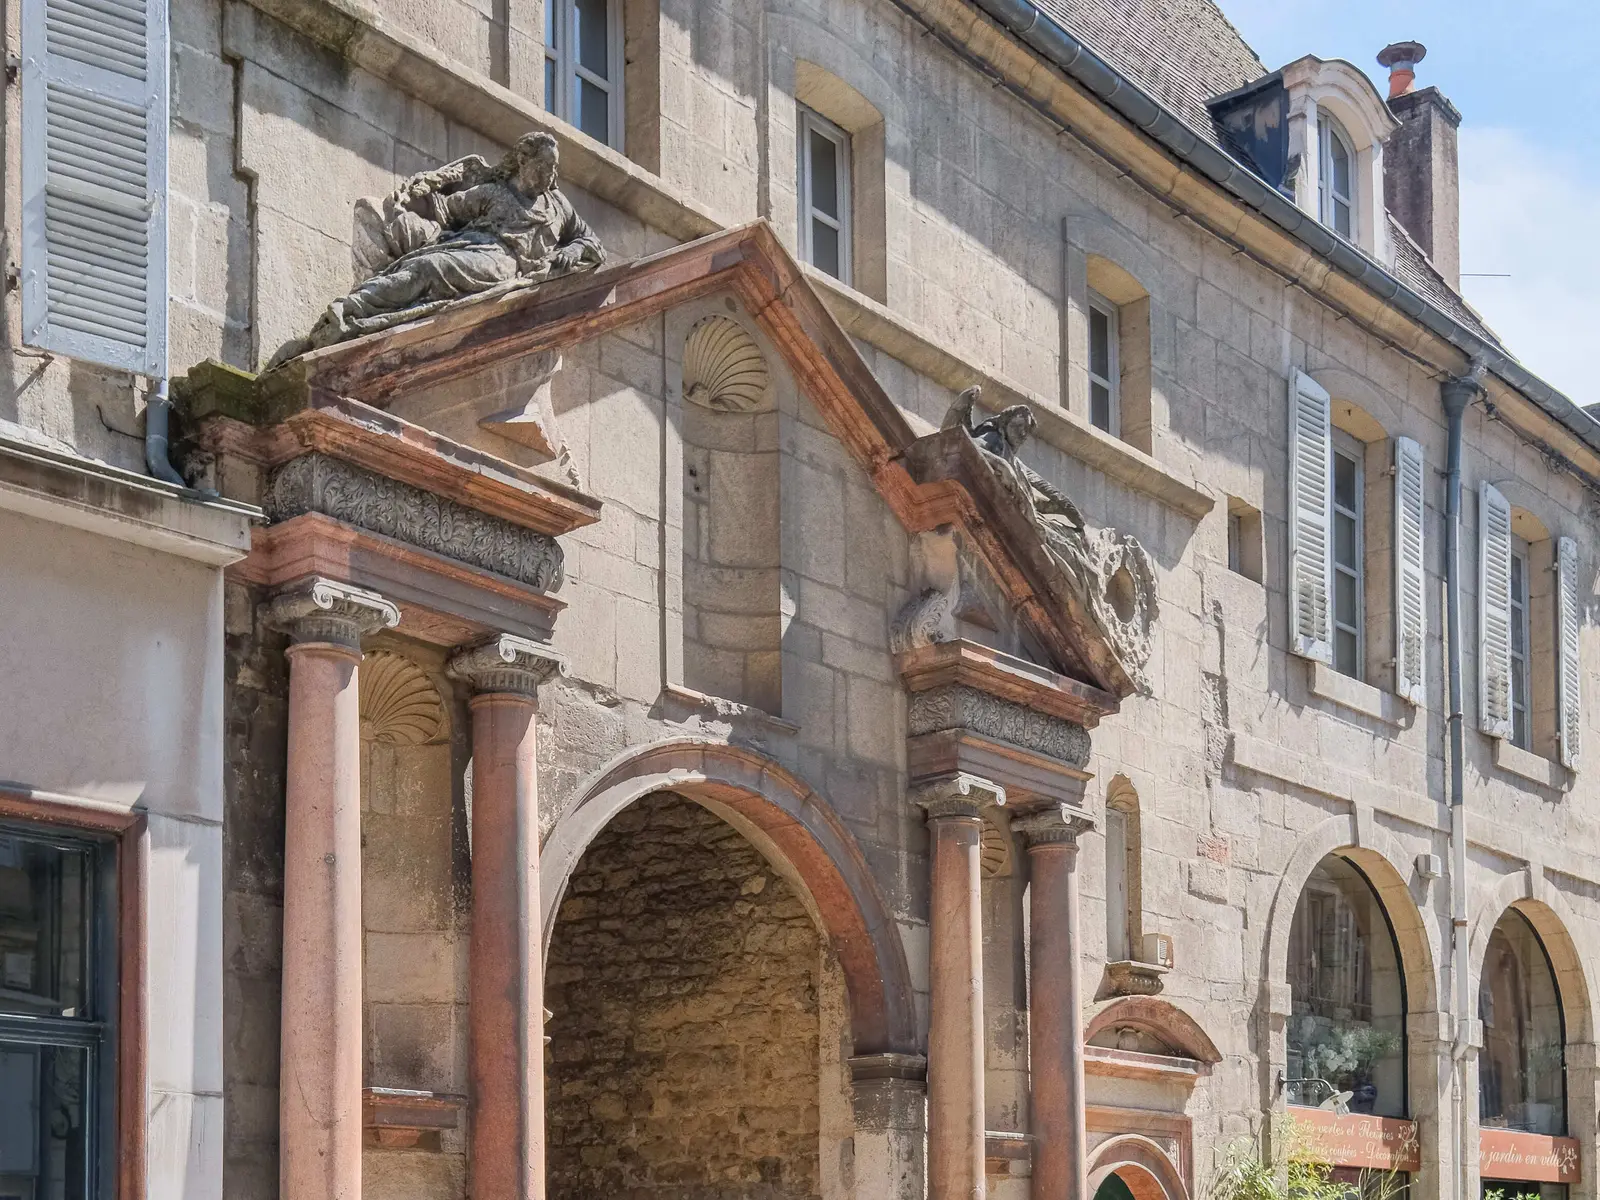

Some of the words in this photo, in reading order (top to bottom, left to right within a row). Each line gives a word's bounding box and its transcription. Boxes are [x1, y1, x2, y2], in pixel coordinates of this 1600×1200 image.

[1318, 1121, 1344, 1136] vertes
[1346, 1123, 1355, 1137] et
[1357, 1120, 1394, 1141] Fleuries
[1484, 1143, 1522, 1171] jardin
[1524, 1153, 1538, 1165] en
[1540, 1147, 1562, 1168] ville
